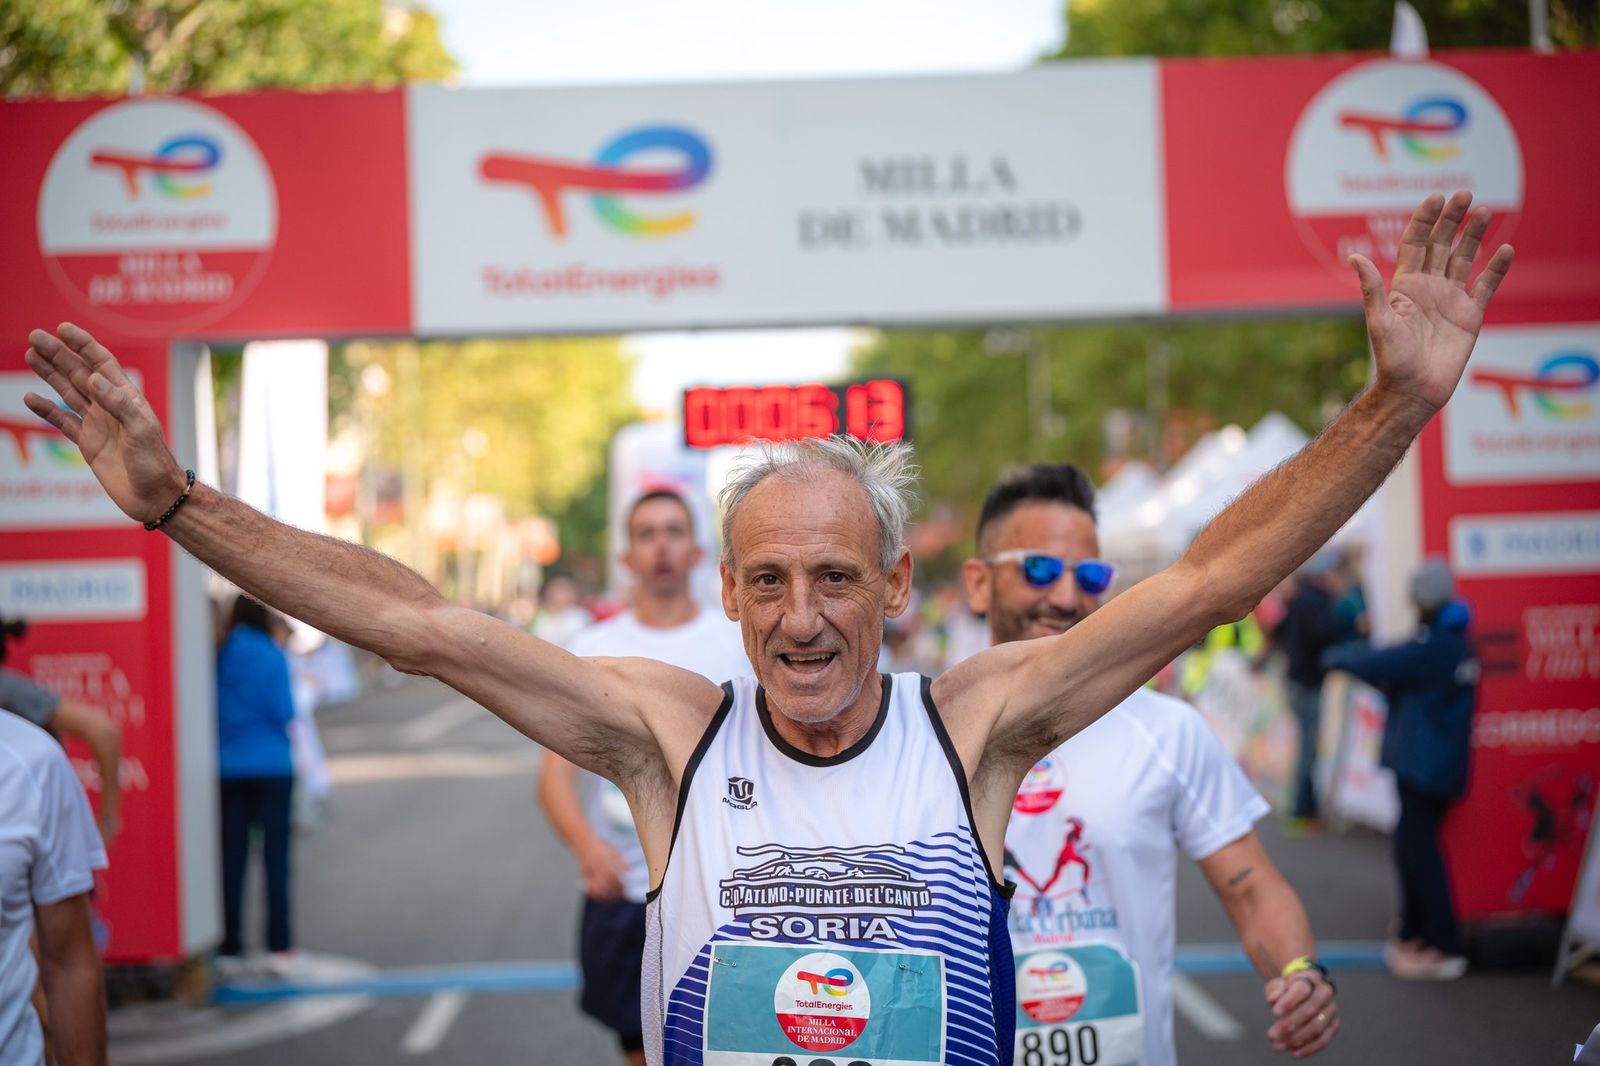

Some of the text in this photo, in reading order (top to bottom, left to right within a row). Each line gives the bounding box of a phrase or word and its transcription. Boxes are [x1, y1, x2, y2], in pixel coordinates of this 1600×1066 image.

[857, 153, 1018, 195] MILLA
[797, 200, 1084, 249] DE MADRID
[483, 264, 721, 302] TotalEnergies
[795, 886, 850, 905] PUENTE
[853, 886, 882, 904] DEL
[884, 886, 932, 908] CANTO
[750, 914, 899, 941] SORIA
[795, 999, 854, 1012] TotalEnergies
[808, 1017, 836, 1027] MILLA
[797, 1035, 846, 1045] DE MADRID
[1022, 1025, 1099, 1066] 890
